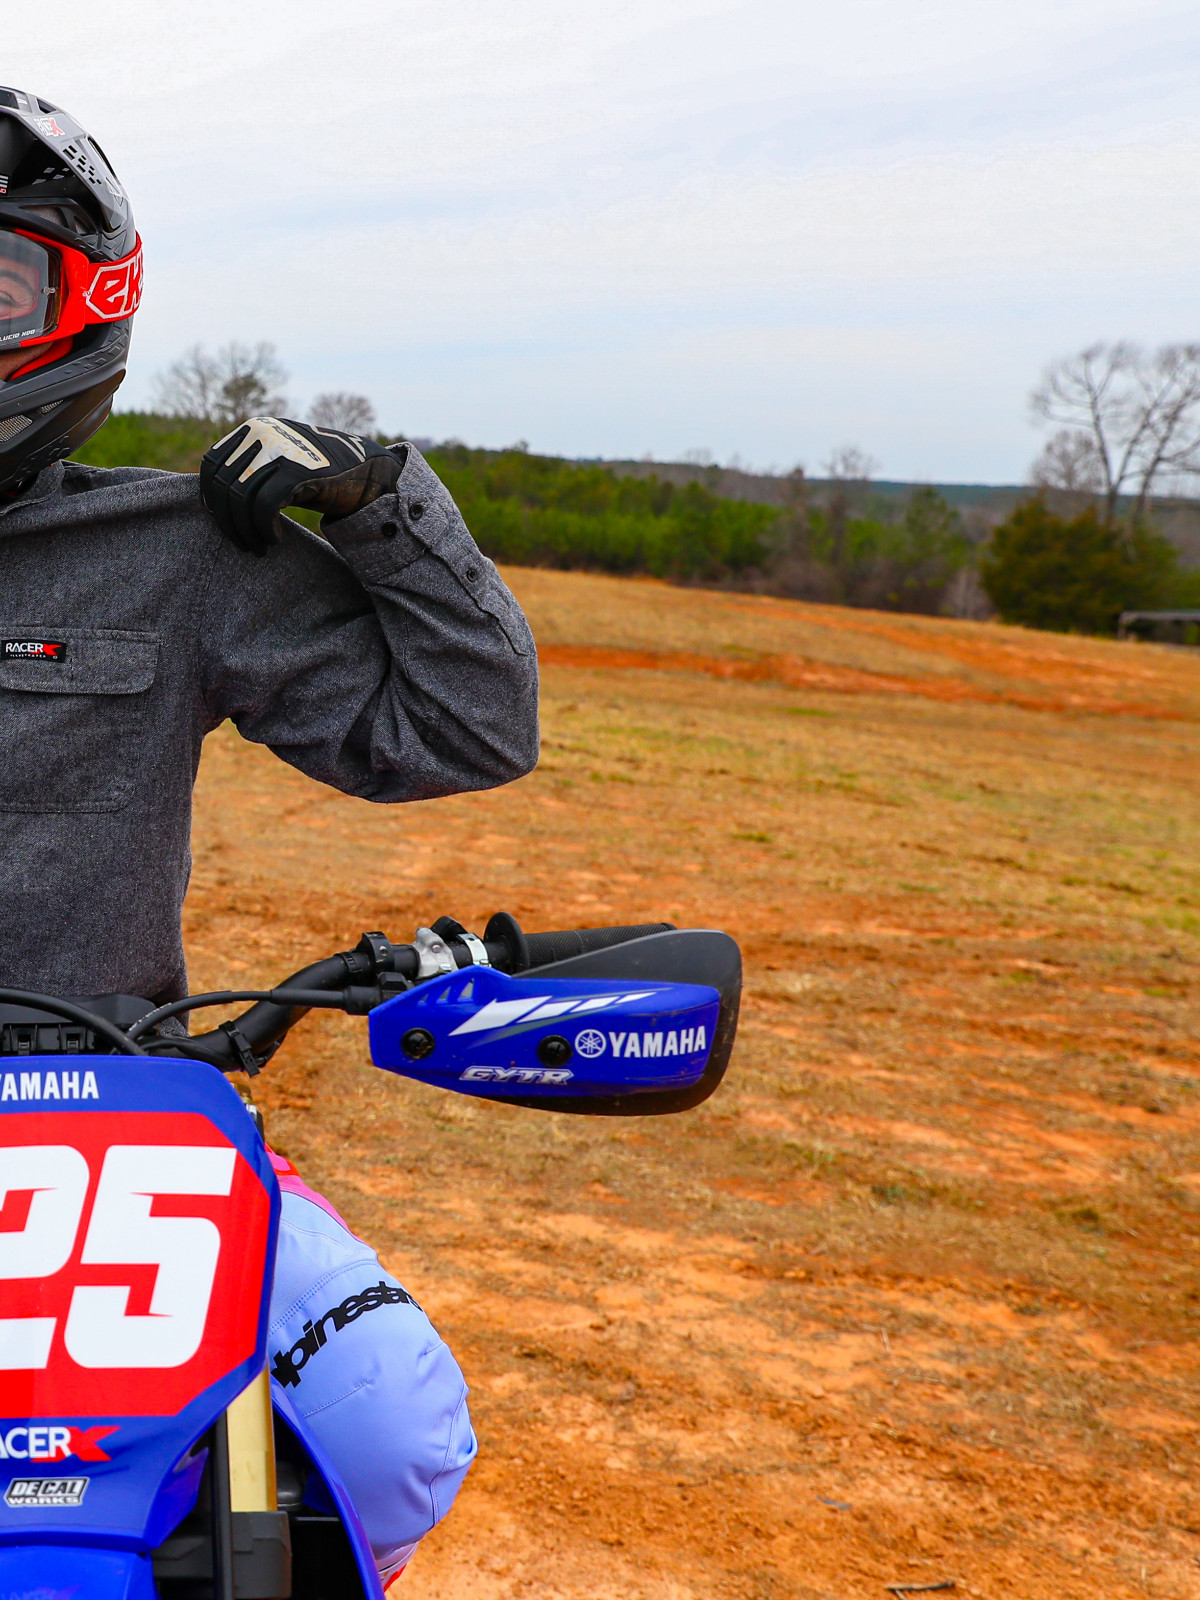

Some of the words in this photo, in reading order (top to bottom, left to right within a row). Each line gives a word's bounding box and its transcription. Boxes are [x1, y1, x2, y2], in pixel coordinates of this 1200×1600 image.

[608, 1026, 706, 1058] YAMAHA
[459, 1065, 574, 1085] GYTR
[11, 1480, 84, 1496] DECAL
[8, 1496, 79, 1504] WORKS
